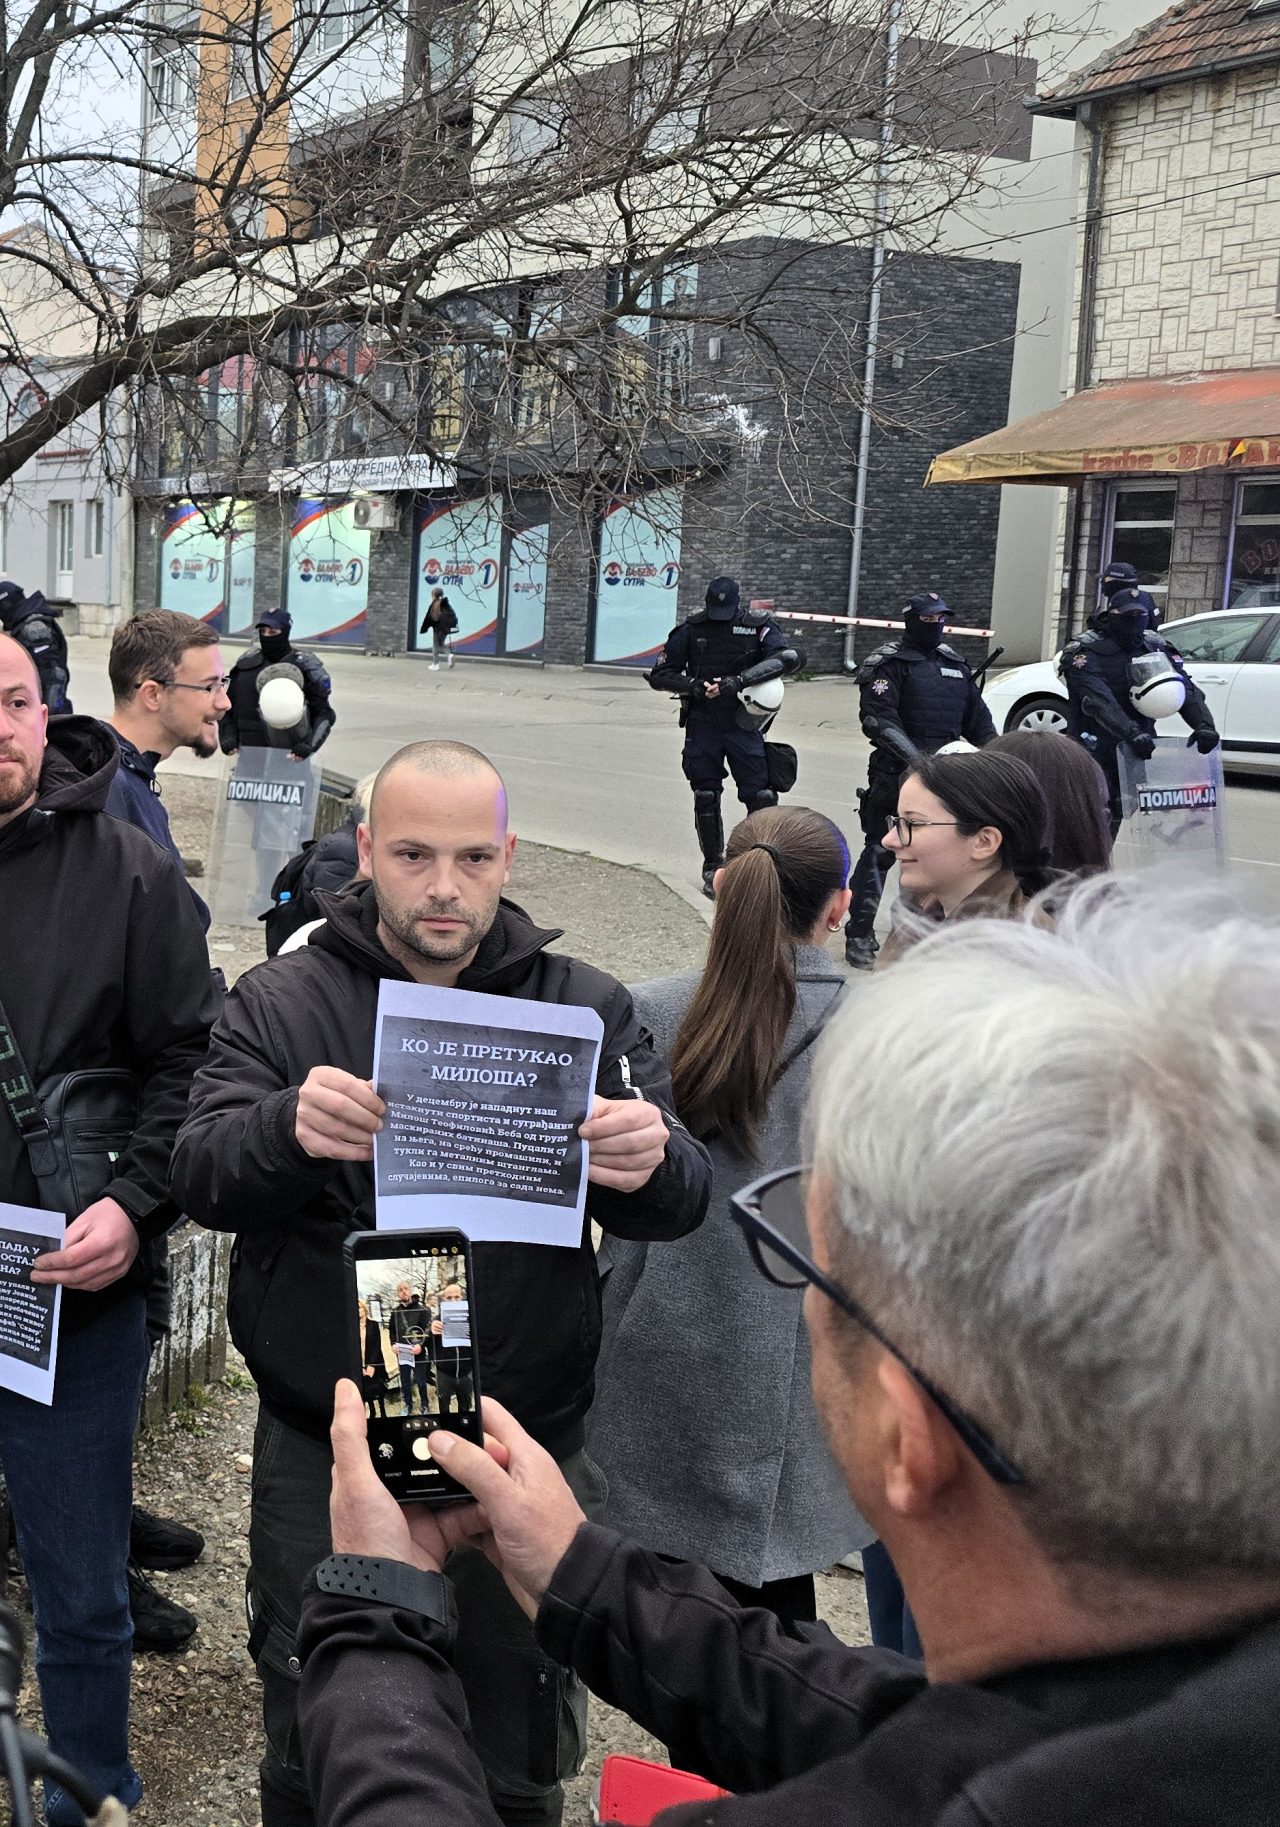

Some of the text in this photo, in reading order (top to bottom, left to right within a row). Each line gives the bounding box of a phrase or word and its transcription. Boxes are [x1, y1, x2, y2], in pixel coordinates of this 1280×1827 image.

[623, 577, 645, 587] СУТРА
[228, 780, 302, 805] ПОЛИЦИЈА
[1139, 788, 1216, 808] ПОЛИЦИЈА
[401, 1038, 573, 1066] КО ЈЕ ПРЕТУКАО
[430, 1065, 538, 1087] МИЛОША?
[416, 1096, 468, 1109] децембру
[469, 1101, 478, 1110] је
[480, 1104, 532, 1115] нападнут
[534, 1108, 557, 1116] наш
[391, 1111, 429, 1123] Милош
[524, 1133, 537, 1141] од
[539, 1134, 568, 1143] групе
[446, 1112, 501, 1124] спортиста
[390, 1123, 454, 1138] маскираних
[513, 1142, 554, 1154] Пуцали
[557, 1148, 567, 1157] су
[394, 1148, 425, 1156] тукли
[409, 1159, 427, 1167] Као
[438, 1161, 444, 1169] у
[510, 1183, 533, 1191] сада
[1, 1253, 35, 1266] ОСТАЈ
